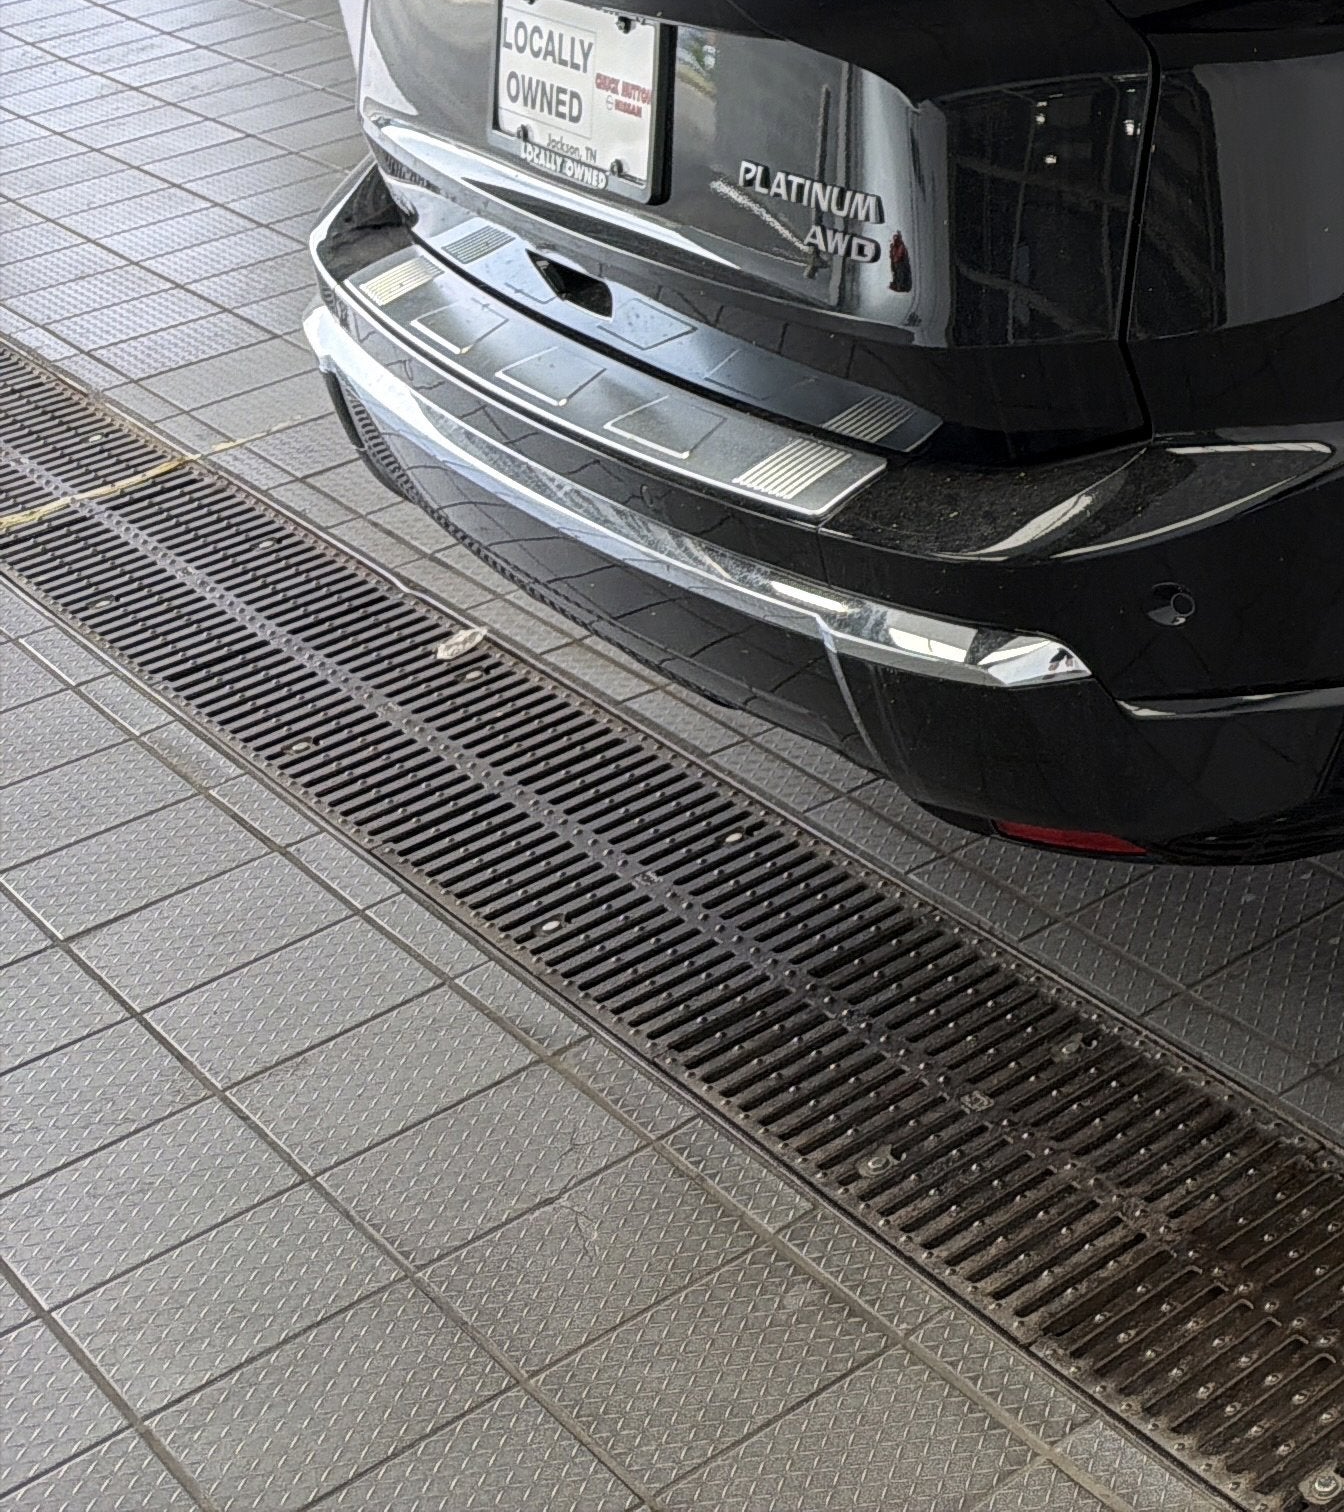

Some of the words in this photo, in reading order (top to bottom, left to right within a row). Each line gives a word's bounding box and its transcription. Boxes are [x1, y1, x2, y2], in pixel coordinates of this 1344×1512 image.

[502, 17, 594, 74] LOCALLY
[506, 70, 583, 124] OWNED
[520, 143, 563, 173] LOCALLY
[564, 158, 607, 189] OWNED
[546, 133, 582, 160] Jackson,
[585, 146, 597, 163] TN
[738, 160, 882, 224] PLATINUM
[804, 224, 880, 263] AWD
